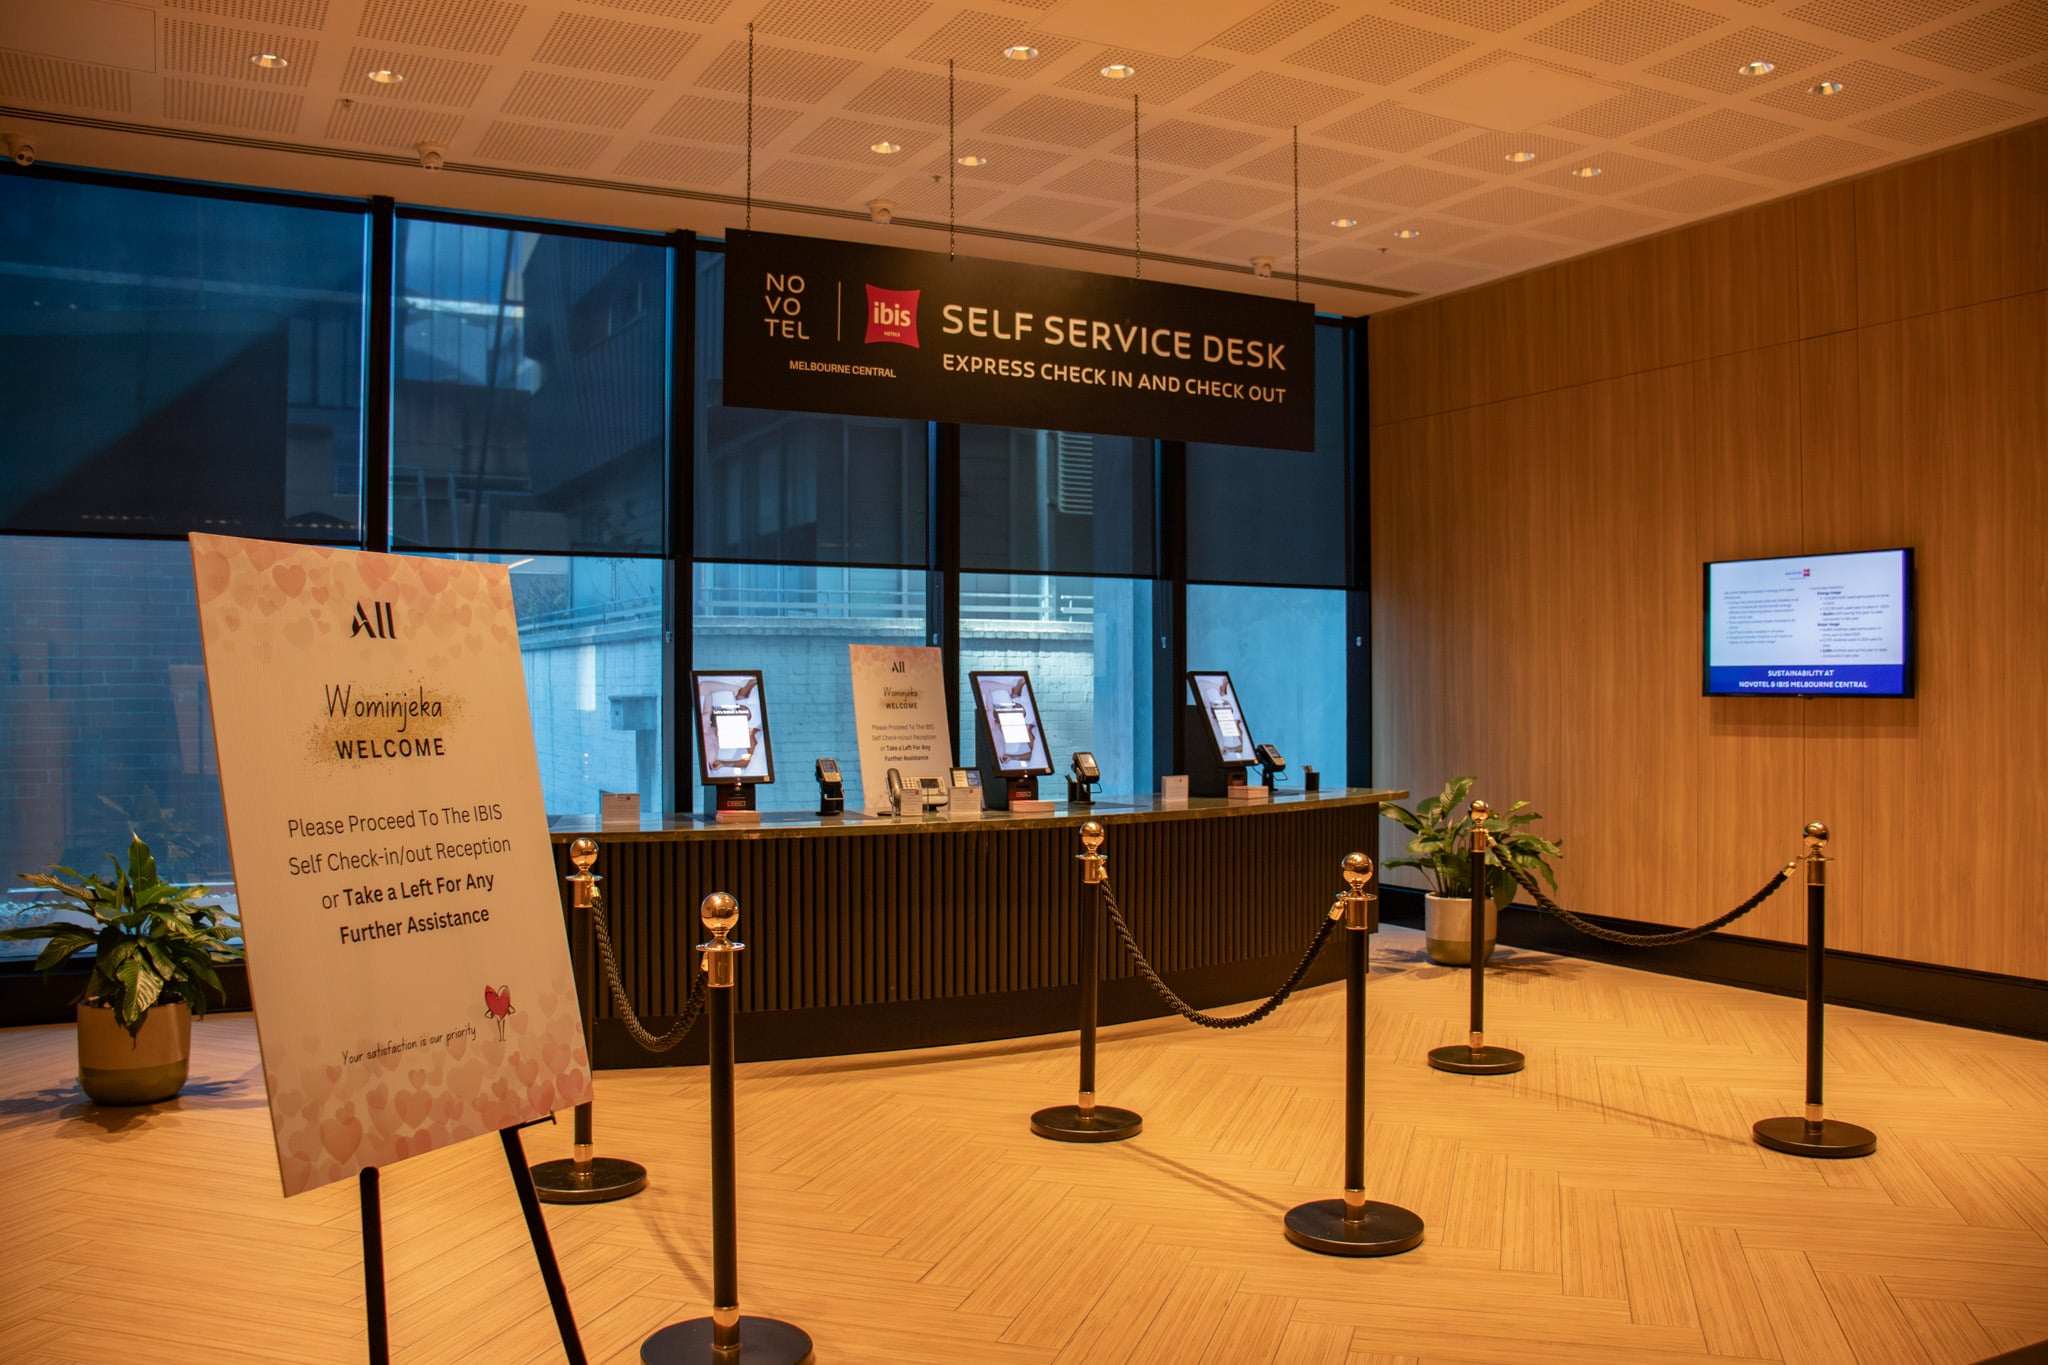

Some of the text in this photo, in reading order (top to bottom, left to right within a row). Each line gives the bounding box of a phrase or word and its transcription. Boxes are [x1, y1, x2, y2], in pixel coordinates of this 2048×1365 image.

[766, 272, 805, 294] NO
[765, 296, 801, 316] VO
[873, 301, 911, 327] ibis
[764, 318, 810, 340] TEL
[942, 304, 1286, 371] SELF SERVICE DESK
[789, 360, 897, 378] MELBOURNE CENTRAL
[943, 353, 1286, 404] EXPRESS CHECK IN AND CHECK OUT
[1824, 669, 1835, 677] AT
[325, 683, 442, 733] Wominjeka
[885, 702, 918, 710] WELCOME
[335, 737, 446, 759] WELCOME
[288, 803, 503, 838] Please Proceed To The IBIS
[288, 836, 512, 876] Self Check-in/out Reception
[321, 872, 495, 910] or Take a Left For Any
[340, 907, 490, 945] Further Assistance
[342, 1022, 477, 1066] Your satisfaction is our priority
